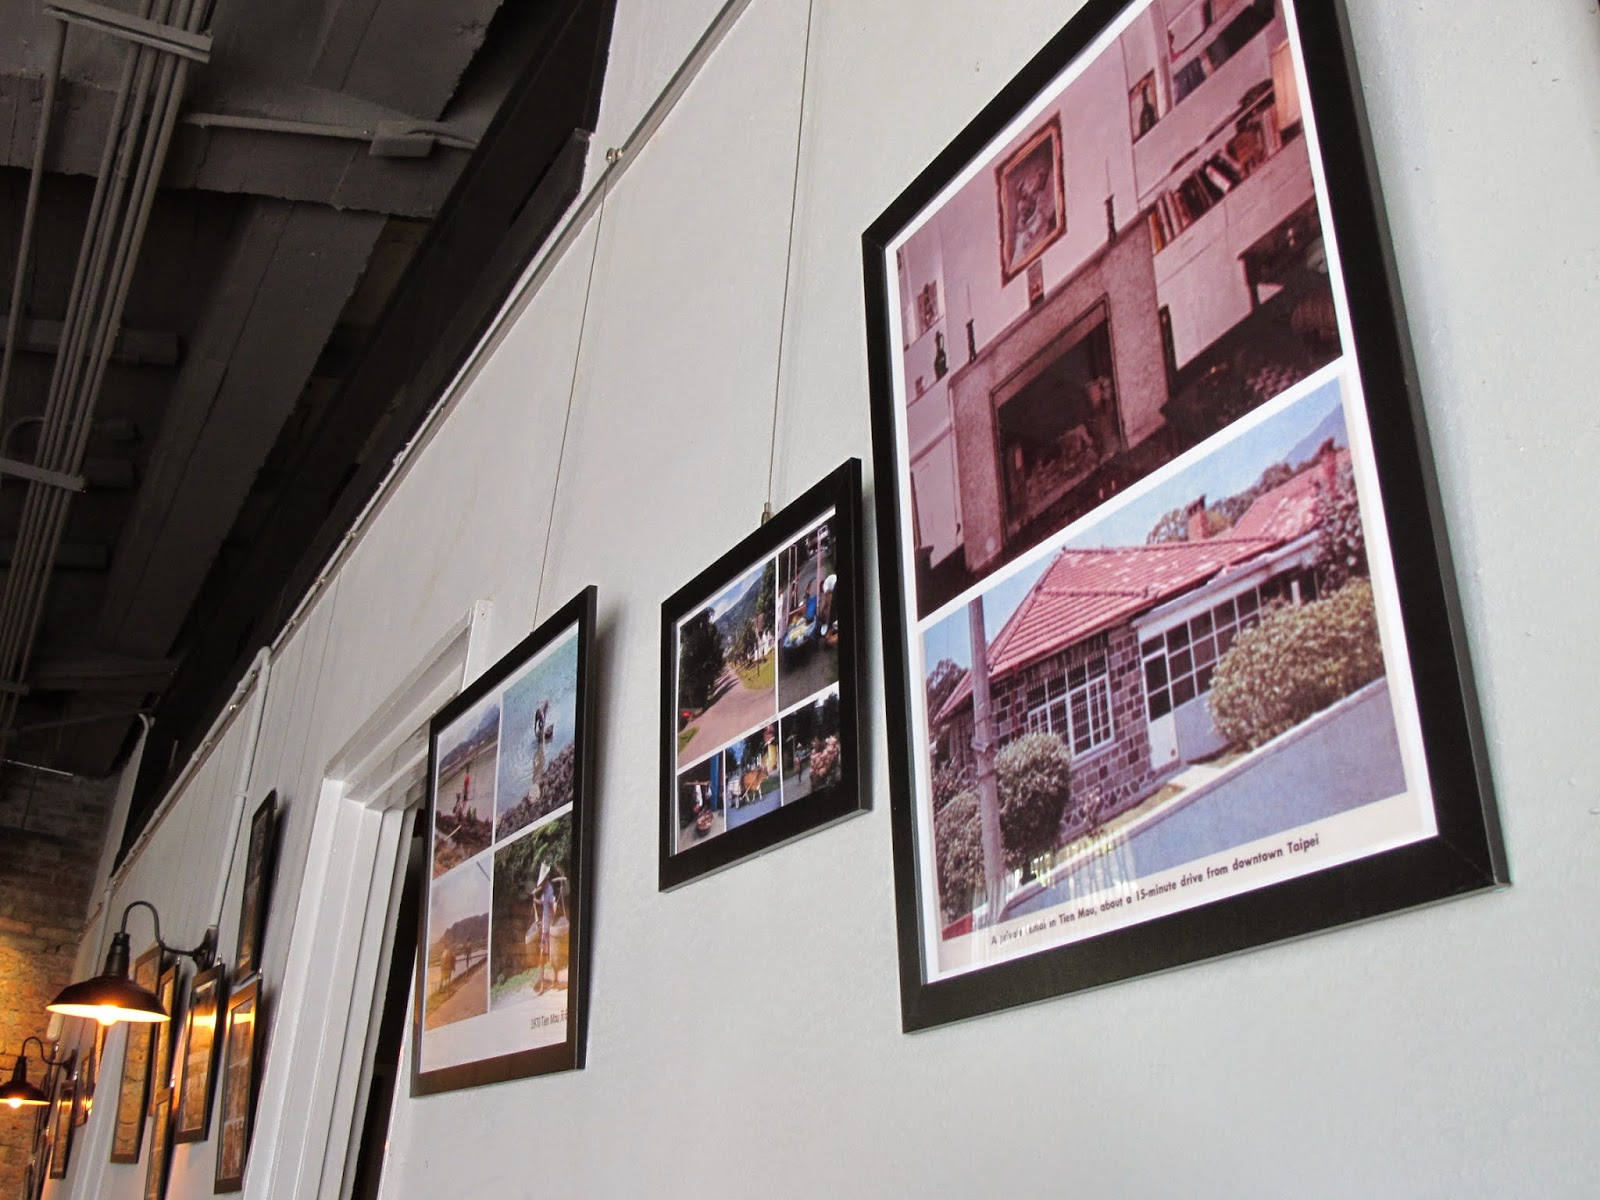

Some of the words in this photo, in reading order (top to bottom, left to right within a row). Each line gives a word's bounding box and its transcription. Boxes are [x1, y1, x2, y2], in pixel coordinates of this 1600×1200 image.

[991, 936, 997, 945] A
[1049, 918, 1056, 928] in
[1059, 912, 1075, 924] Tien
[1078, 907, 1097, 919] Mou,
[1100, 897, 1123, 912] about
[1126, 895, 1132, 905] a
[1136, 881, 1177, 901] 15-minute
[1180, 872, 1203, 887] drive
[1206, 865, 1228, 879] from
[1232, 848, 1283, 871] downtown
[1287, 832, 1319, 854] Taipei
